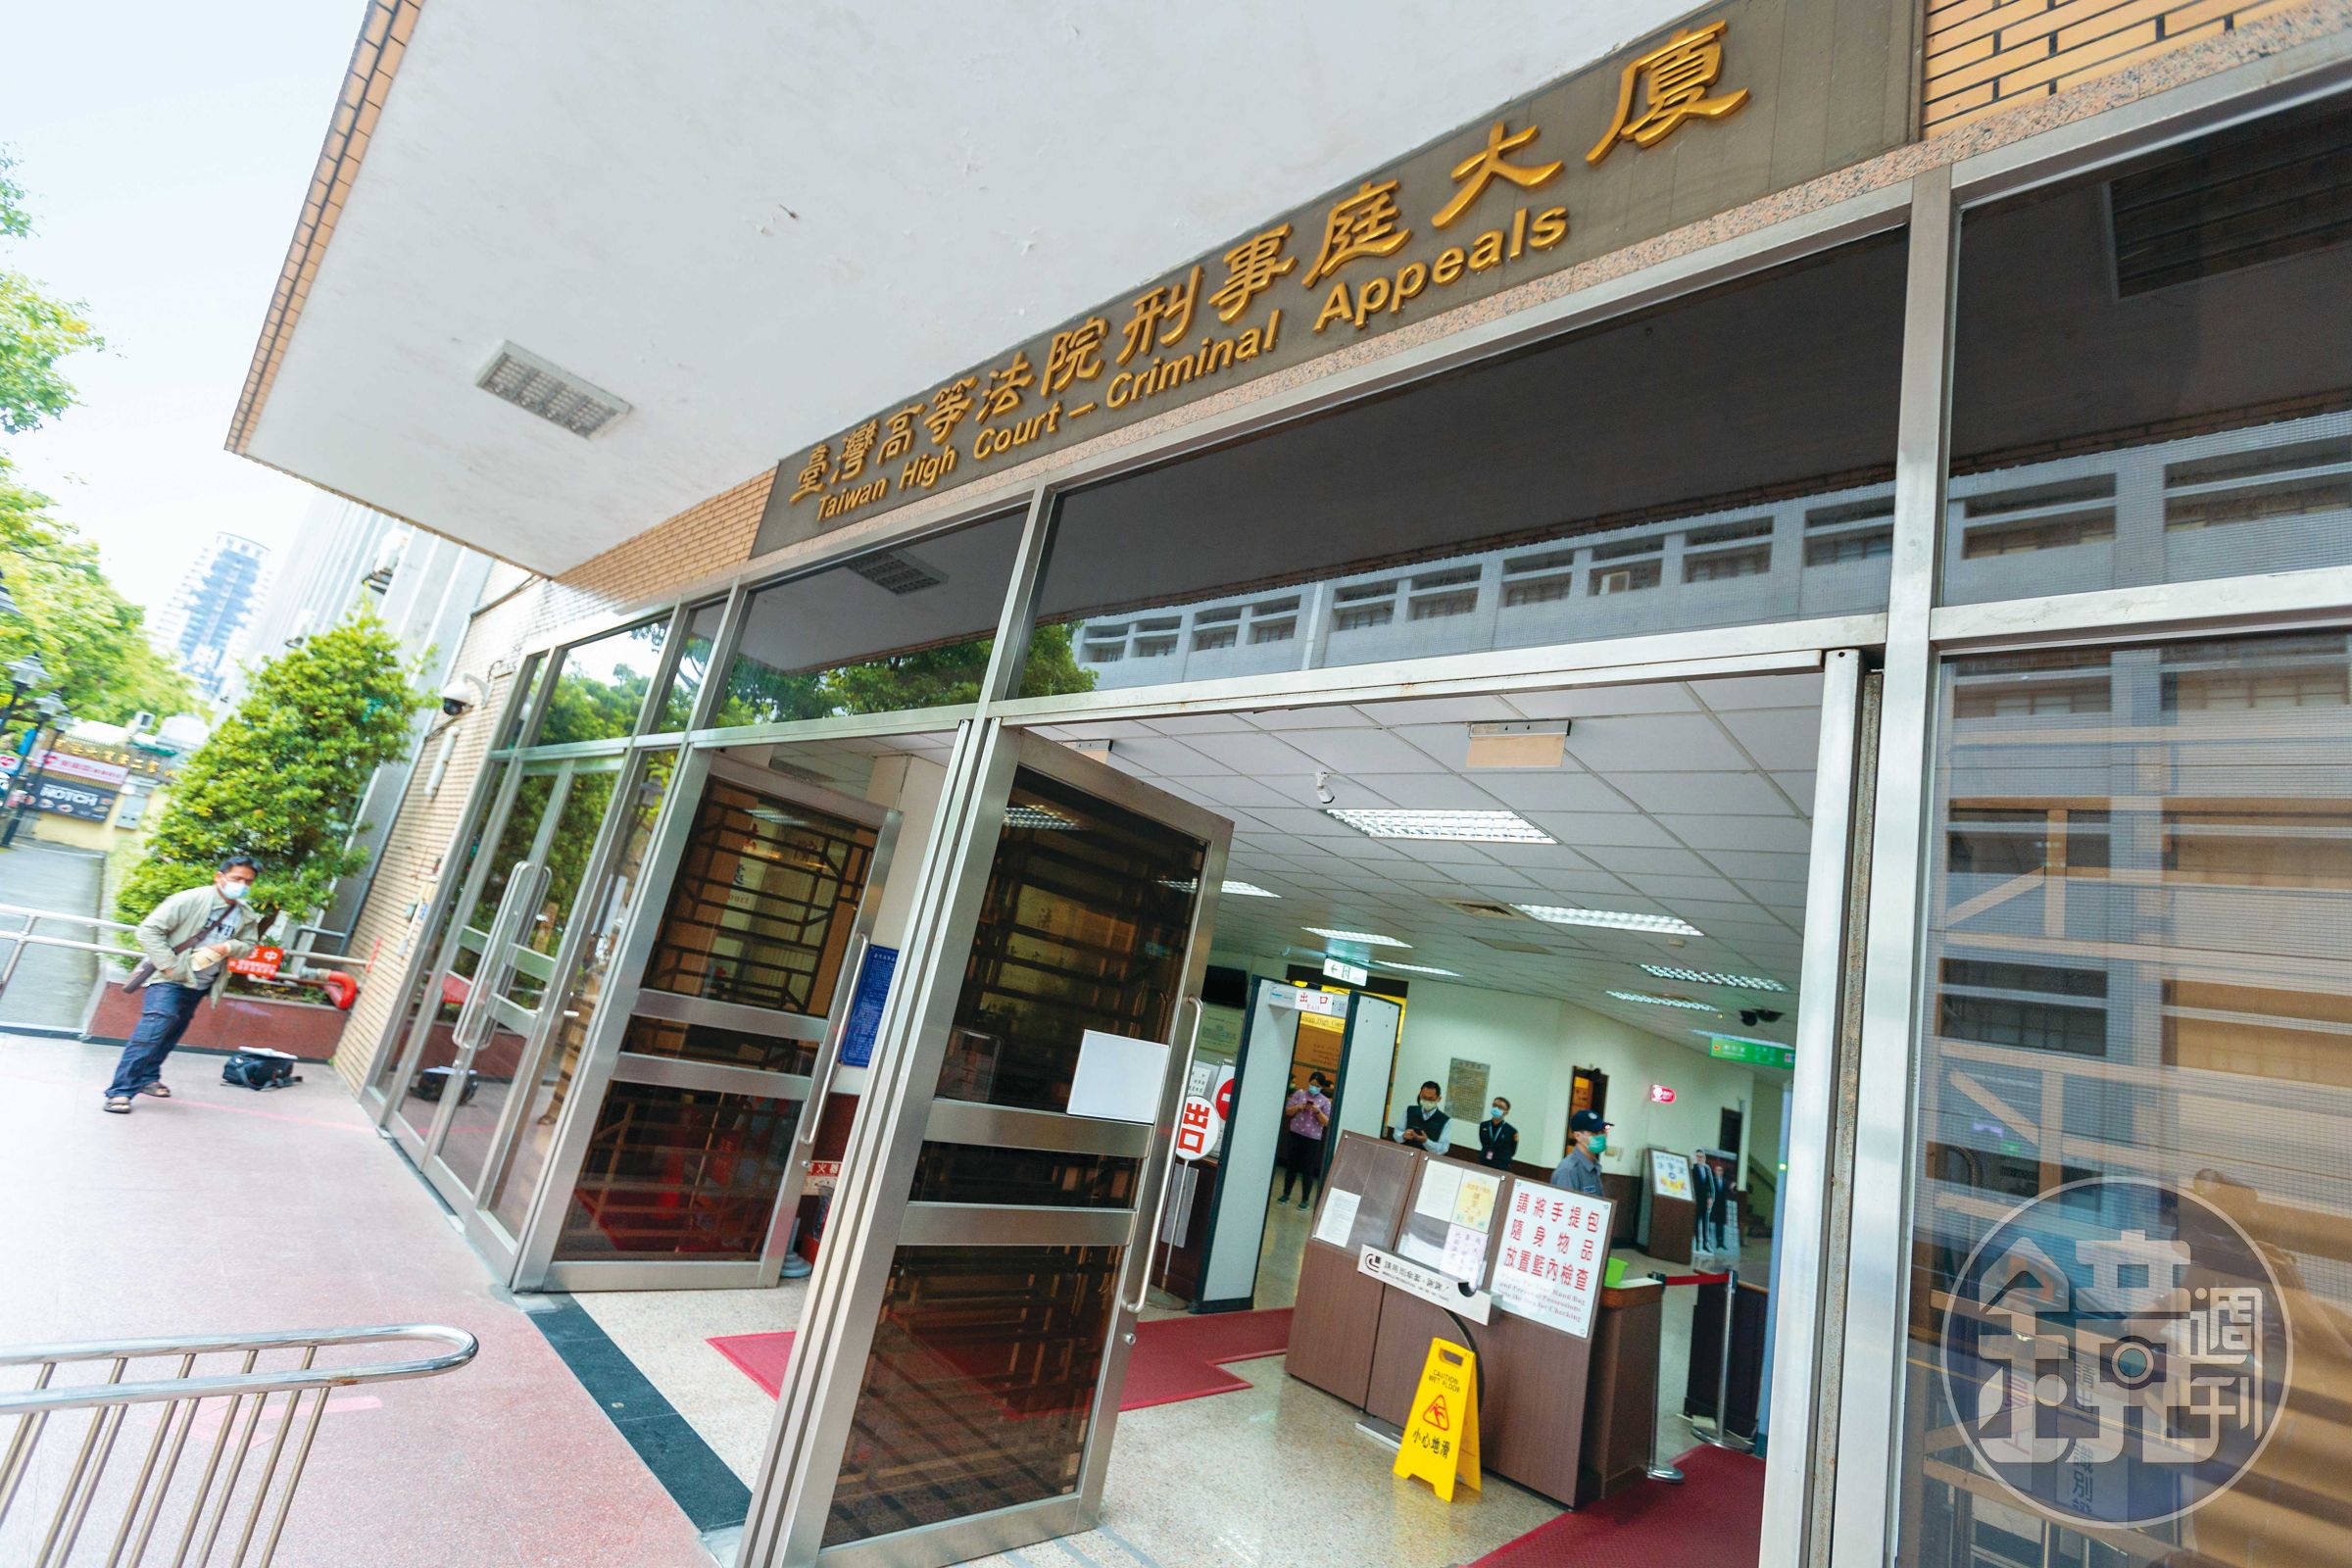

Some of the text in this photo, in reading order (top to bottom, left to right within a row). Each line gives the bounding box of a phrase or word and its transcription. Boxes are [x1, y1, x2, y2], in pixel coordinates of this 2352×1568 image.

[789, 19, 1749, 506] 臺灣高等法院刑事庭大廈
[816, 477, 887, 522] Taiwan
[899, 445, 956, 491] High
[973, 402, 1061, 460] Court
[1106, 309, 1281, 406] Criminal
[1315, 204, 1568, 332] Appeals
[728, 893, 750, 905] ourt
[1299, 992, 1329, 1004] 出口
[1178, 1102, 1210, 1154] 出口
[1516, 1192, 1600, 1233] 請將手提包
[1510, 1219, 1594, 1261] 隨身物品
[1428, 1374, 1460, 1393] WET FLOOR
[1433, 1368, 1459, 1386] CAUTION
[1411, 1427, 1451, 1459] 小心地滑
